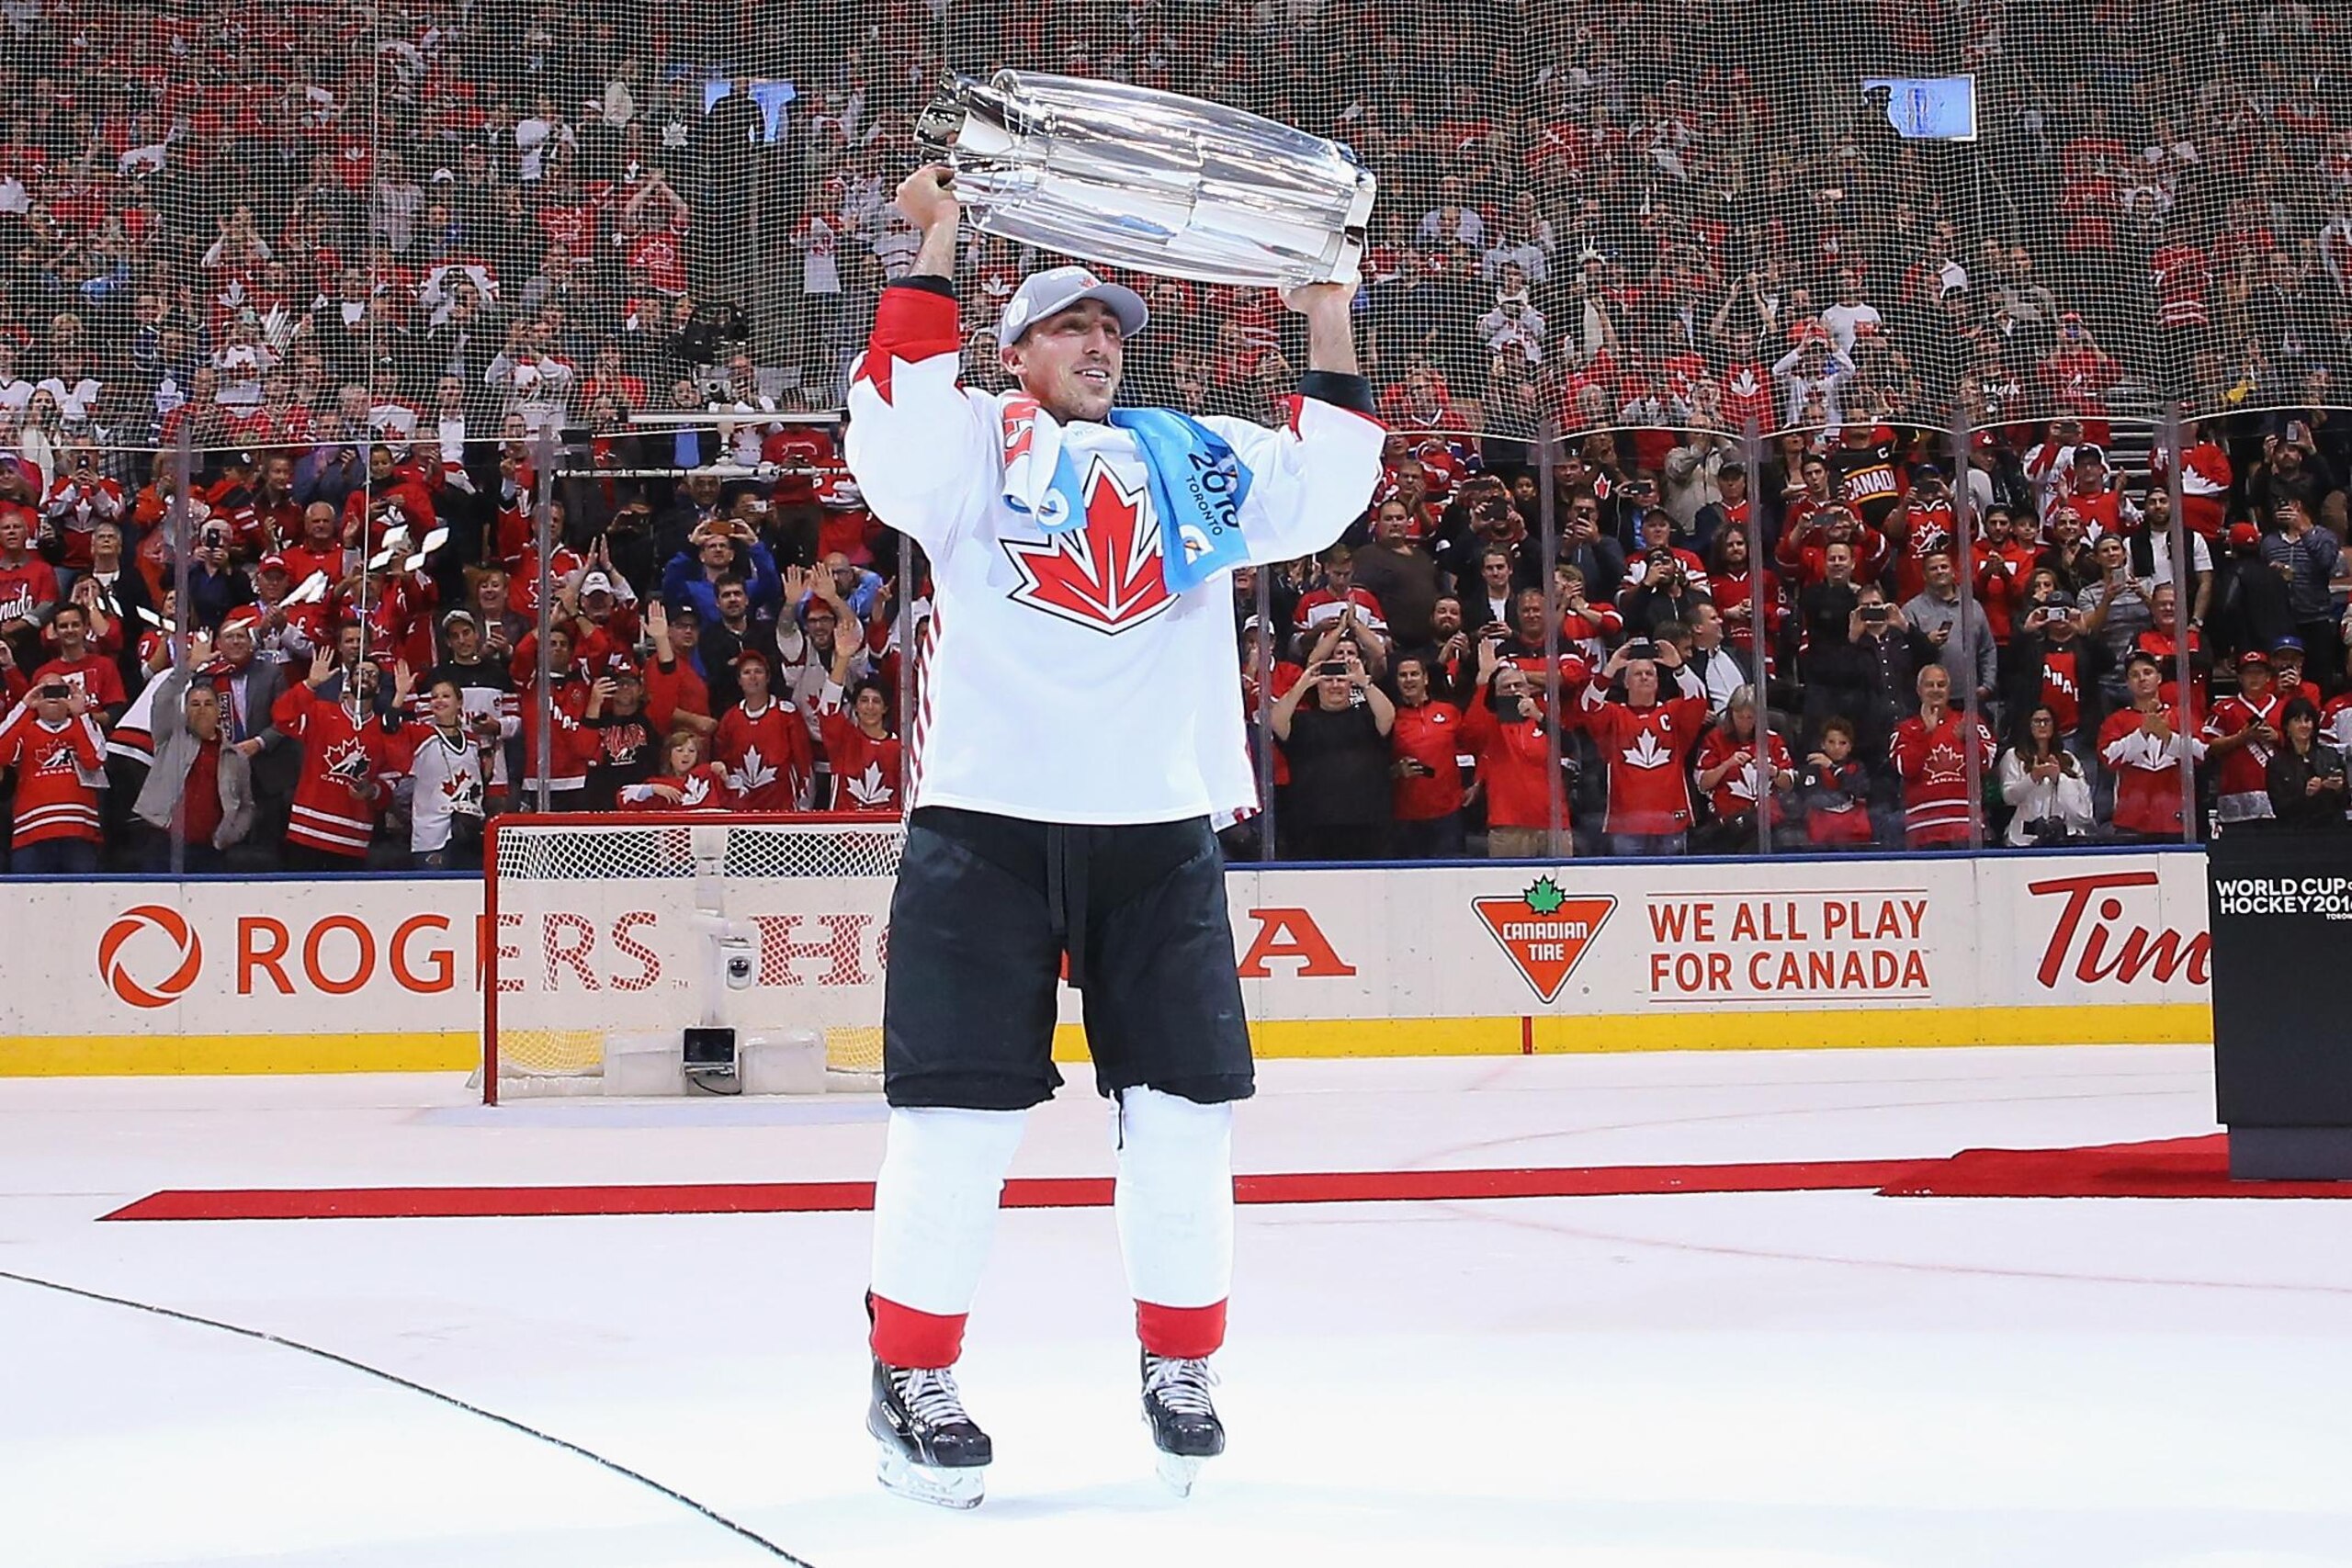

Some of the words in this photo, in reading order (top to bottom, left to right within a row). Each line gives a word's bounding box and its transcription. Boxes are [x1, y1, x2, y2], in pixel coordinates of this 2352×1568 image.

[1185, 476, 1224, 536] TORONTO
[1659, 714, 1671, 731] C
[2215, 878, 2298, 897] WORLD
[2301, 877, 2346, 896] CUP
[1502, 921, 1588, 941] CANADIAN
[1646, 903, 1715, 942] WE
[1730, 902, 1808, 942] ALL
[1823, 899, 1928, 941] PLAY
[2028, 870, 2211, 989] Tim
[236, 910, 662, 996] ROGERS
[1527, 943, 1565, 962] TIRE
[1650, 951, 1733, 993] FOR
[1747, 949, 1929, 991] CANADA
